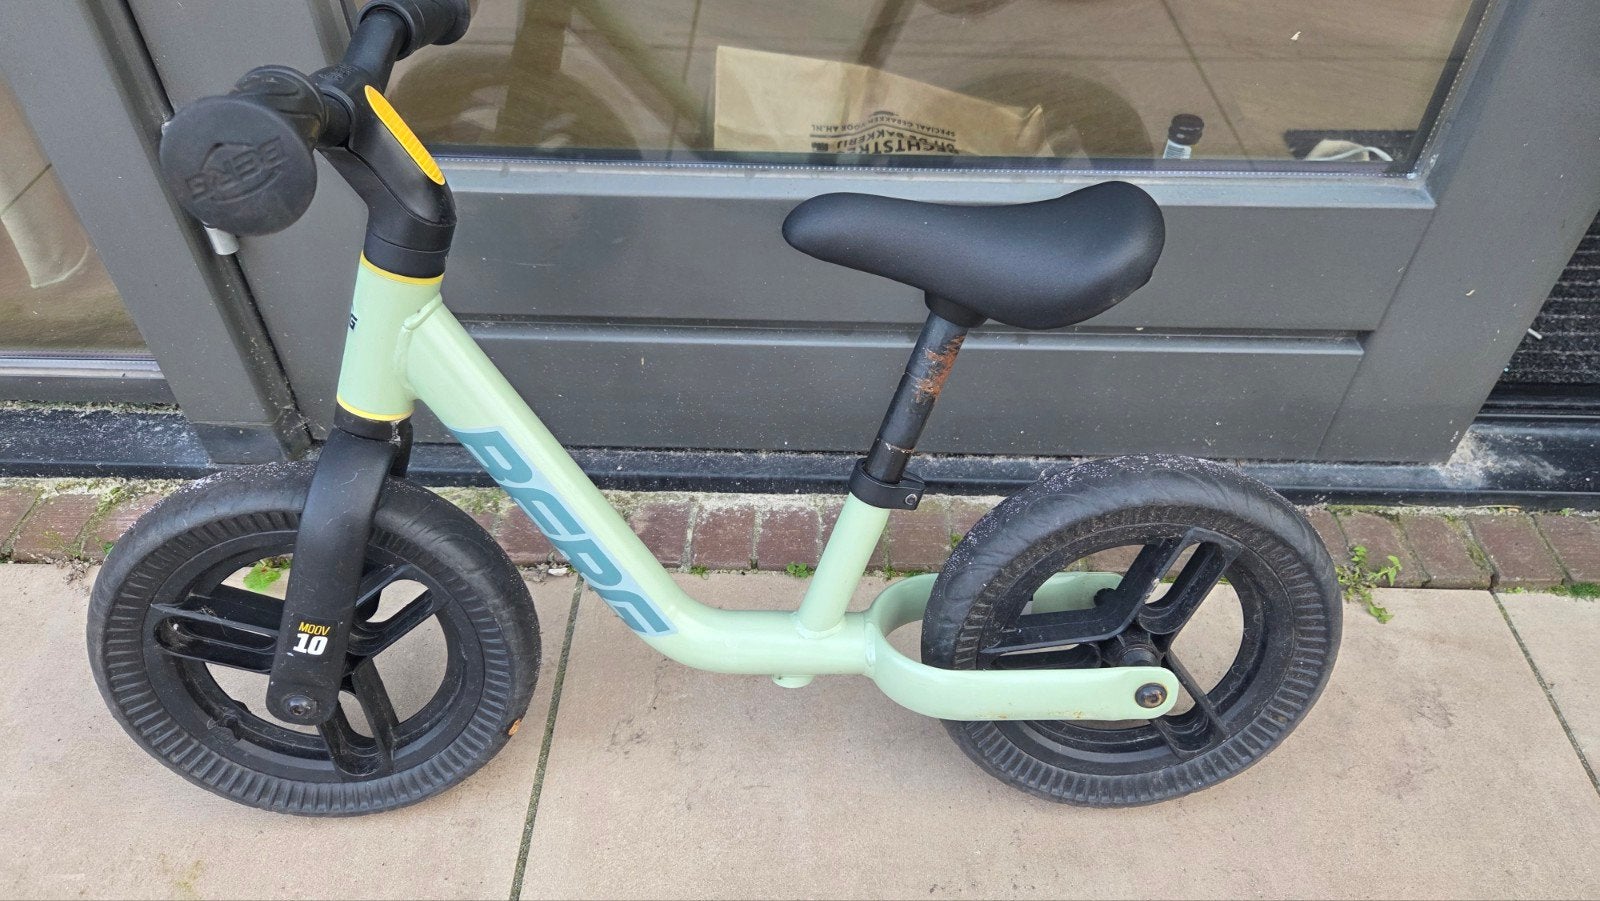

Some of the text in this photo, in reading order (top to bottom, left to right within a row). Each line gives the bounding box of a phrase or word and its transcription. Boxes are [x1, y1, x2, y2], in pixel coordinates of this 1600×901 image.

[841, 122, 865, 131] VOOR
[915, 123, 956, 137] SPECIAAL
[298, 621, 331, 635] MOOV
[293, 633, 328, 655] 10
